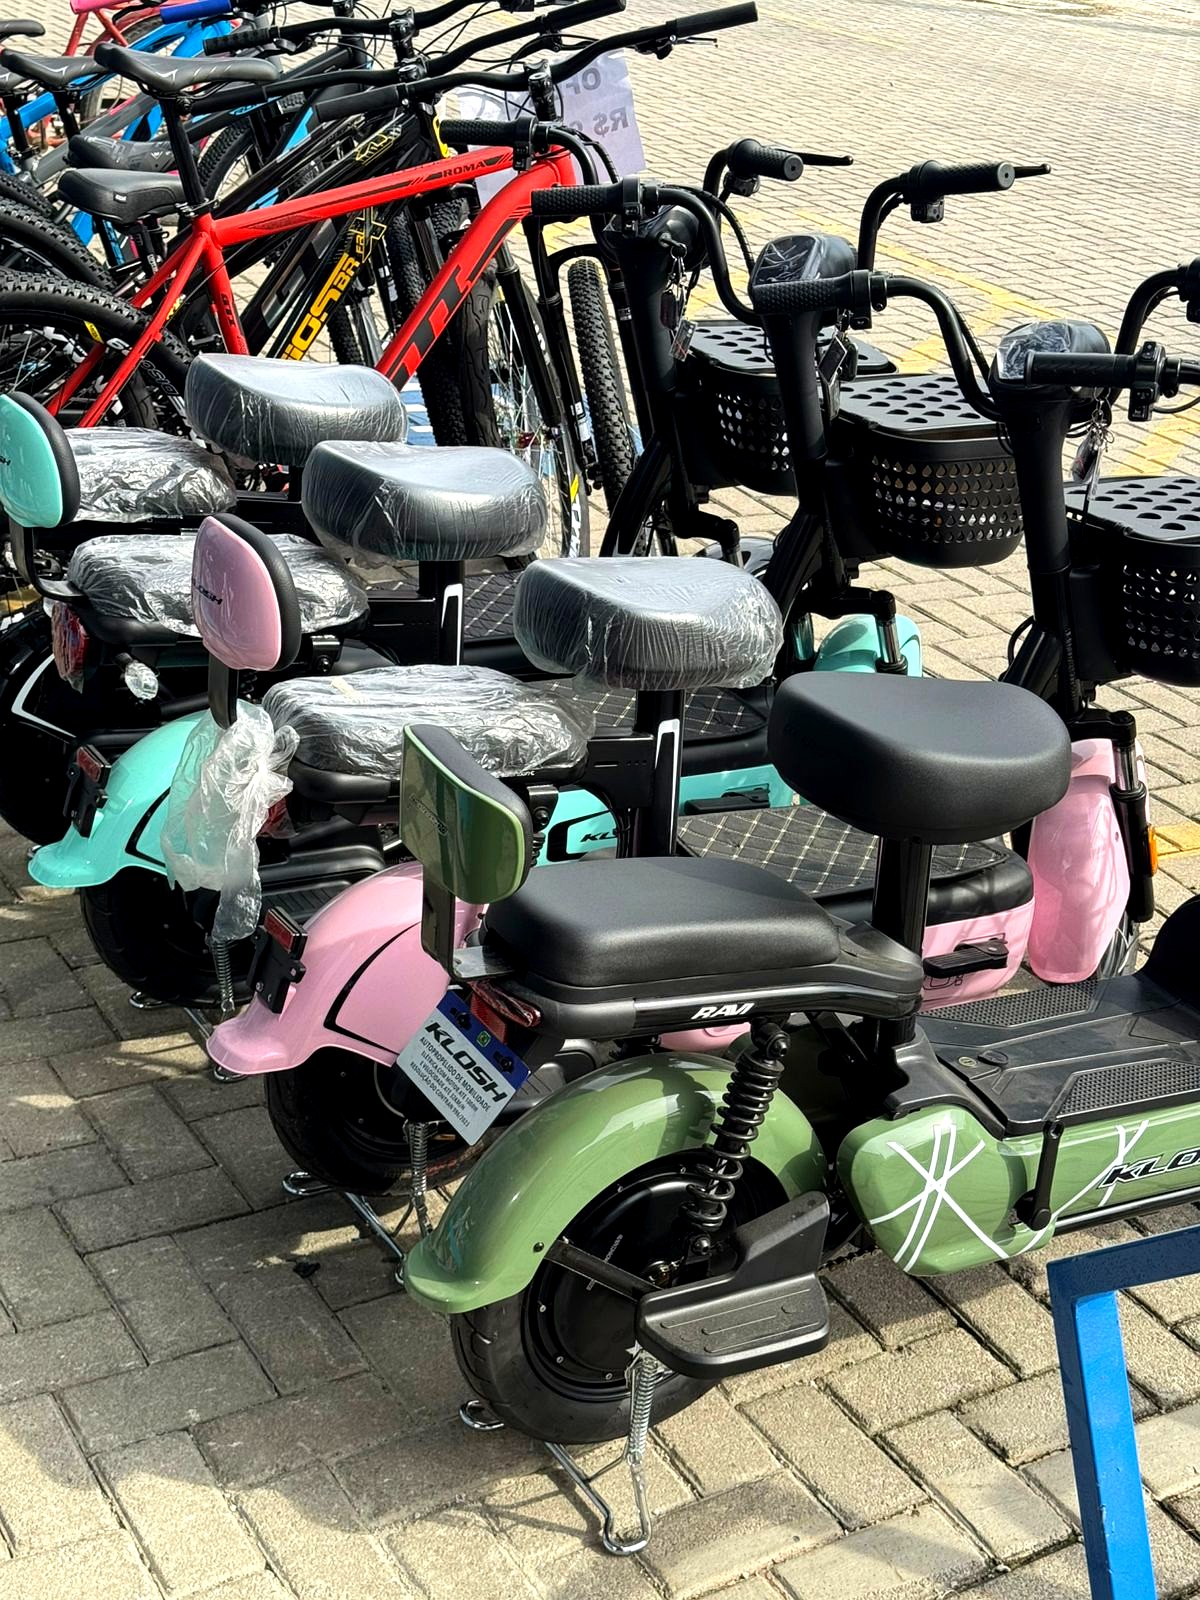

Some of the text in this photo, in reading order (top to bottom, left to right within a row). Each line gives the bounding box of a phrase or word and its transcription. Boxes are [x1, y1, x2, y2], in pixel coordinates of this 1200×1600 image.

[443, 160, 486, 179] ROMA
[690, 1002, 755, 1020] RAVI
[418, 1036, 491, 1112] AUTOPROPELIDO DE MOBILIDADE
[425, 1022, 508, 1103] KLOSH
[421, 1063, 445, 1088] VELOCIDADE
[436, 1067, 448, 1079] COM
[444, 1076, 460, 1092] MOTOR
[434, 1088, 455, 1109] CONTRAN
[1097, 1146, 1200, 1189] KLO
